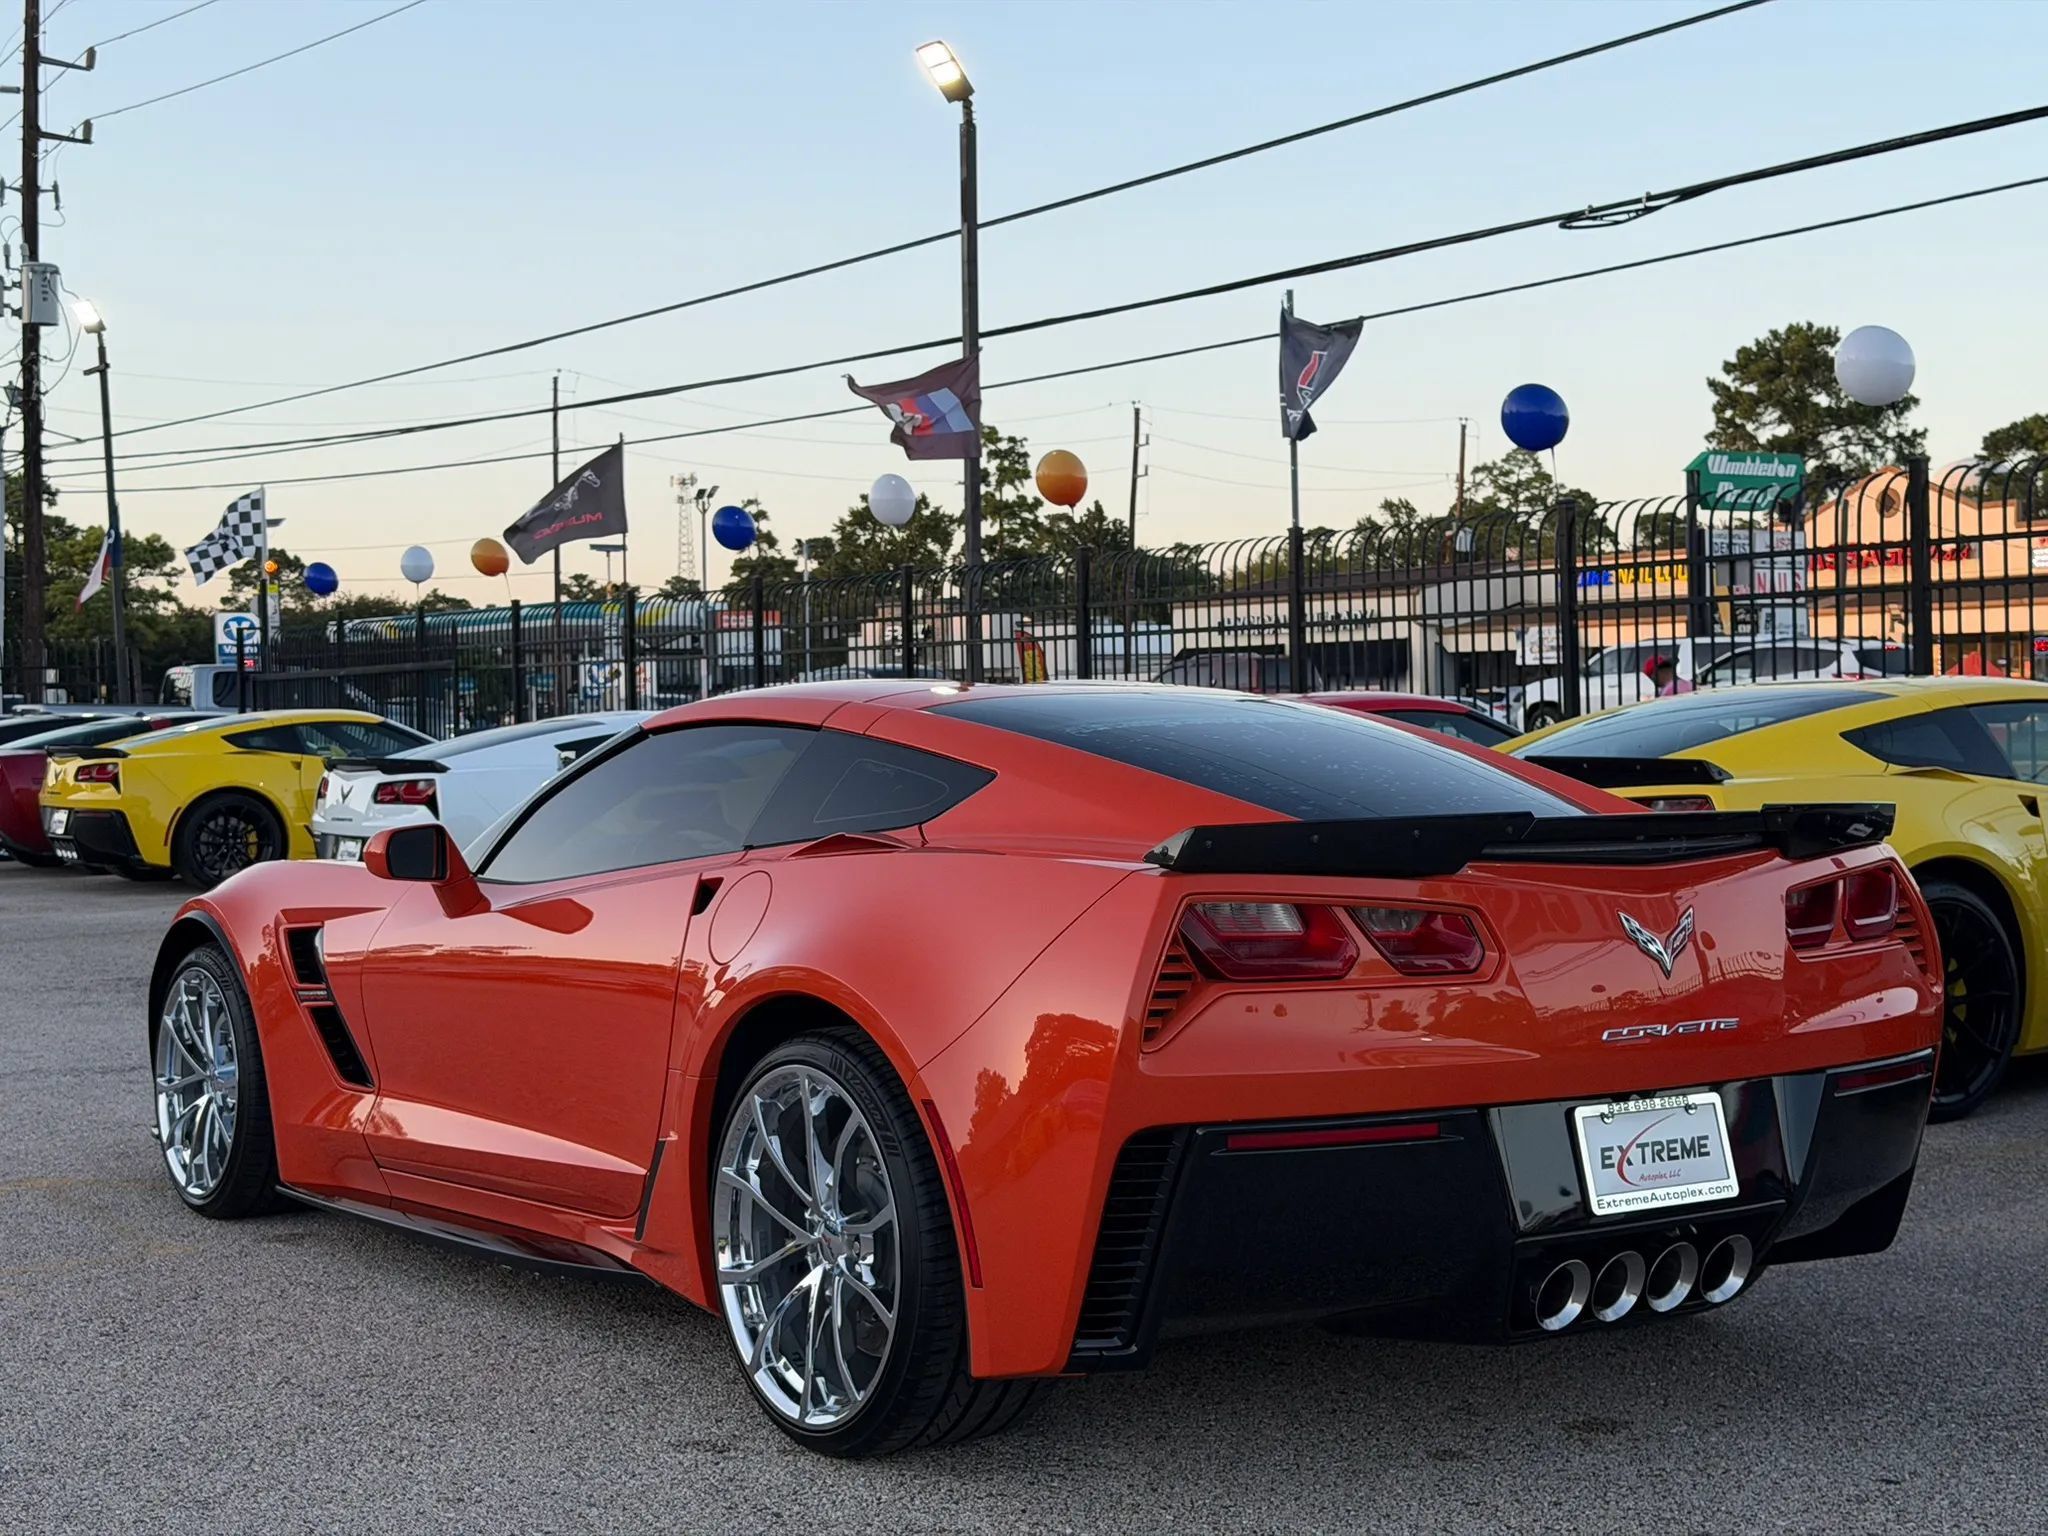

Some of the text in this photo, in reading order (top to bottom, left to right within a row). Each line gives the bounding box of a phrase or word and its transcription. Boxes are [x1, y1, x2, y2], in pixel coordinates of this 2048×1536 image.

[1707, 454, 1797, 478] Wimbledon
[1602, 1018, 1740, 1041] CORVETTE
[1600, 1135, 1711, 1170] EXTREME
[1597, 1184, 1734, 1210] ExtremeAutoplex.com
